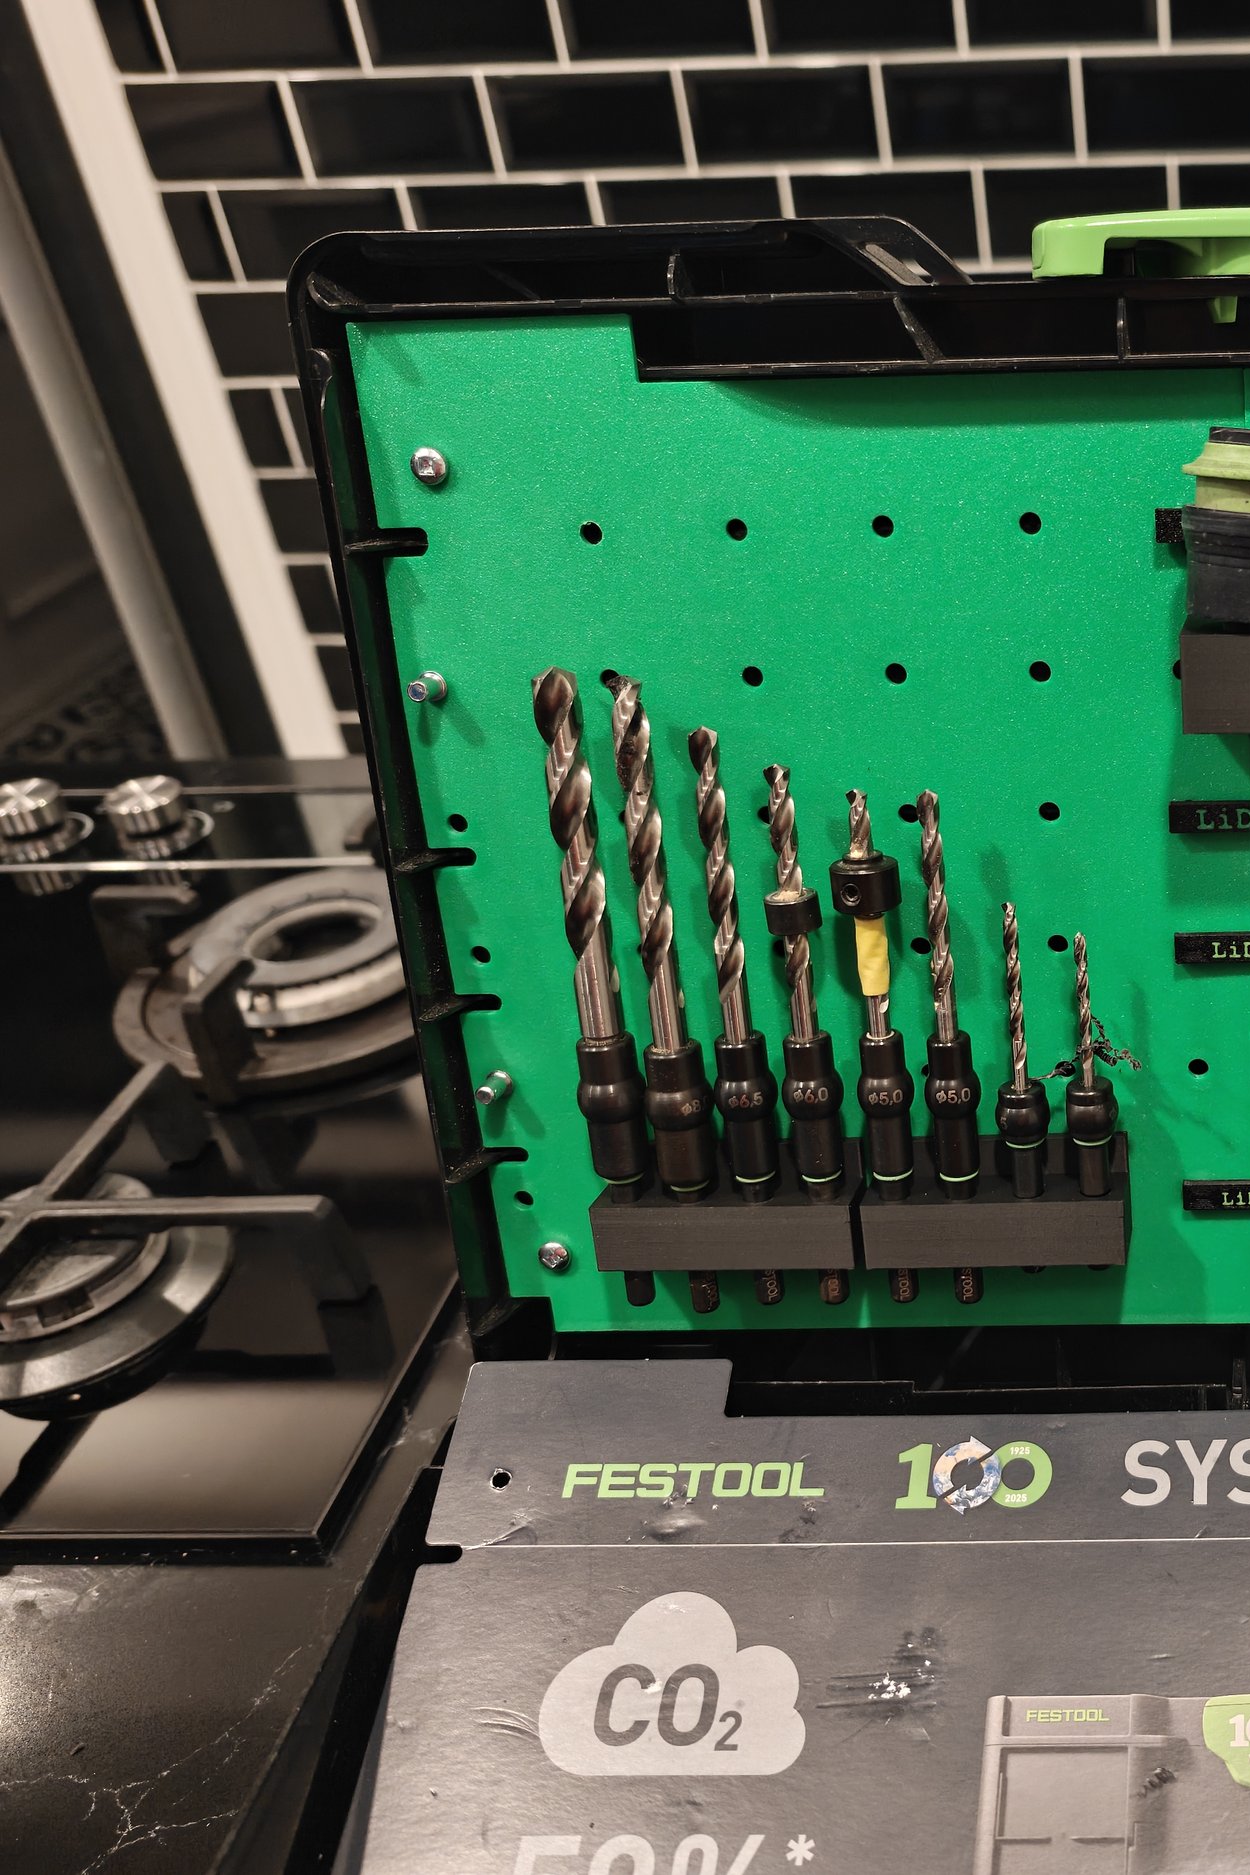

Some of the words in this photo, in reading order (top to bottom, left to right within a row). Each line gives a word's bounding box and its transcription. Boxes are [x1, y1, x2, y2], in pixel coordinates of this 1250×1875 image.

[1009, 1446, 1031, 1455] 1925
[561, 1461, 825, 1498] FESTOOL
[1004, 1493, 1028, 1503] 2025
[1025, 1708, 1110, 1722] FESTOOL
